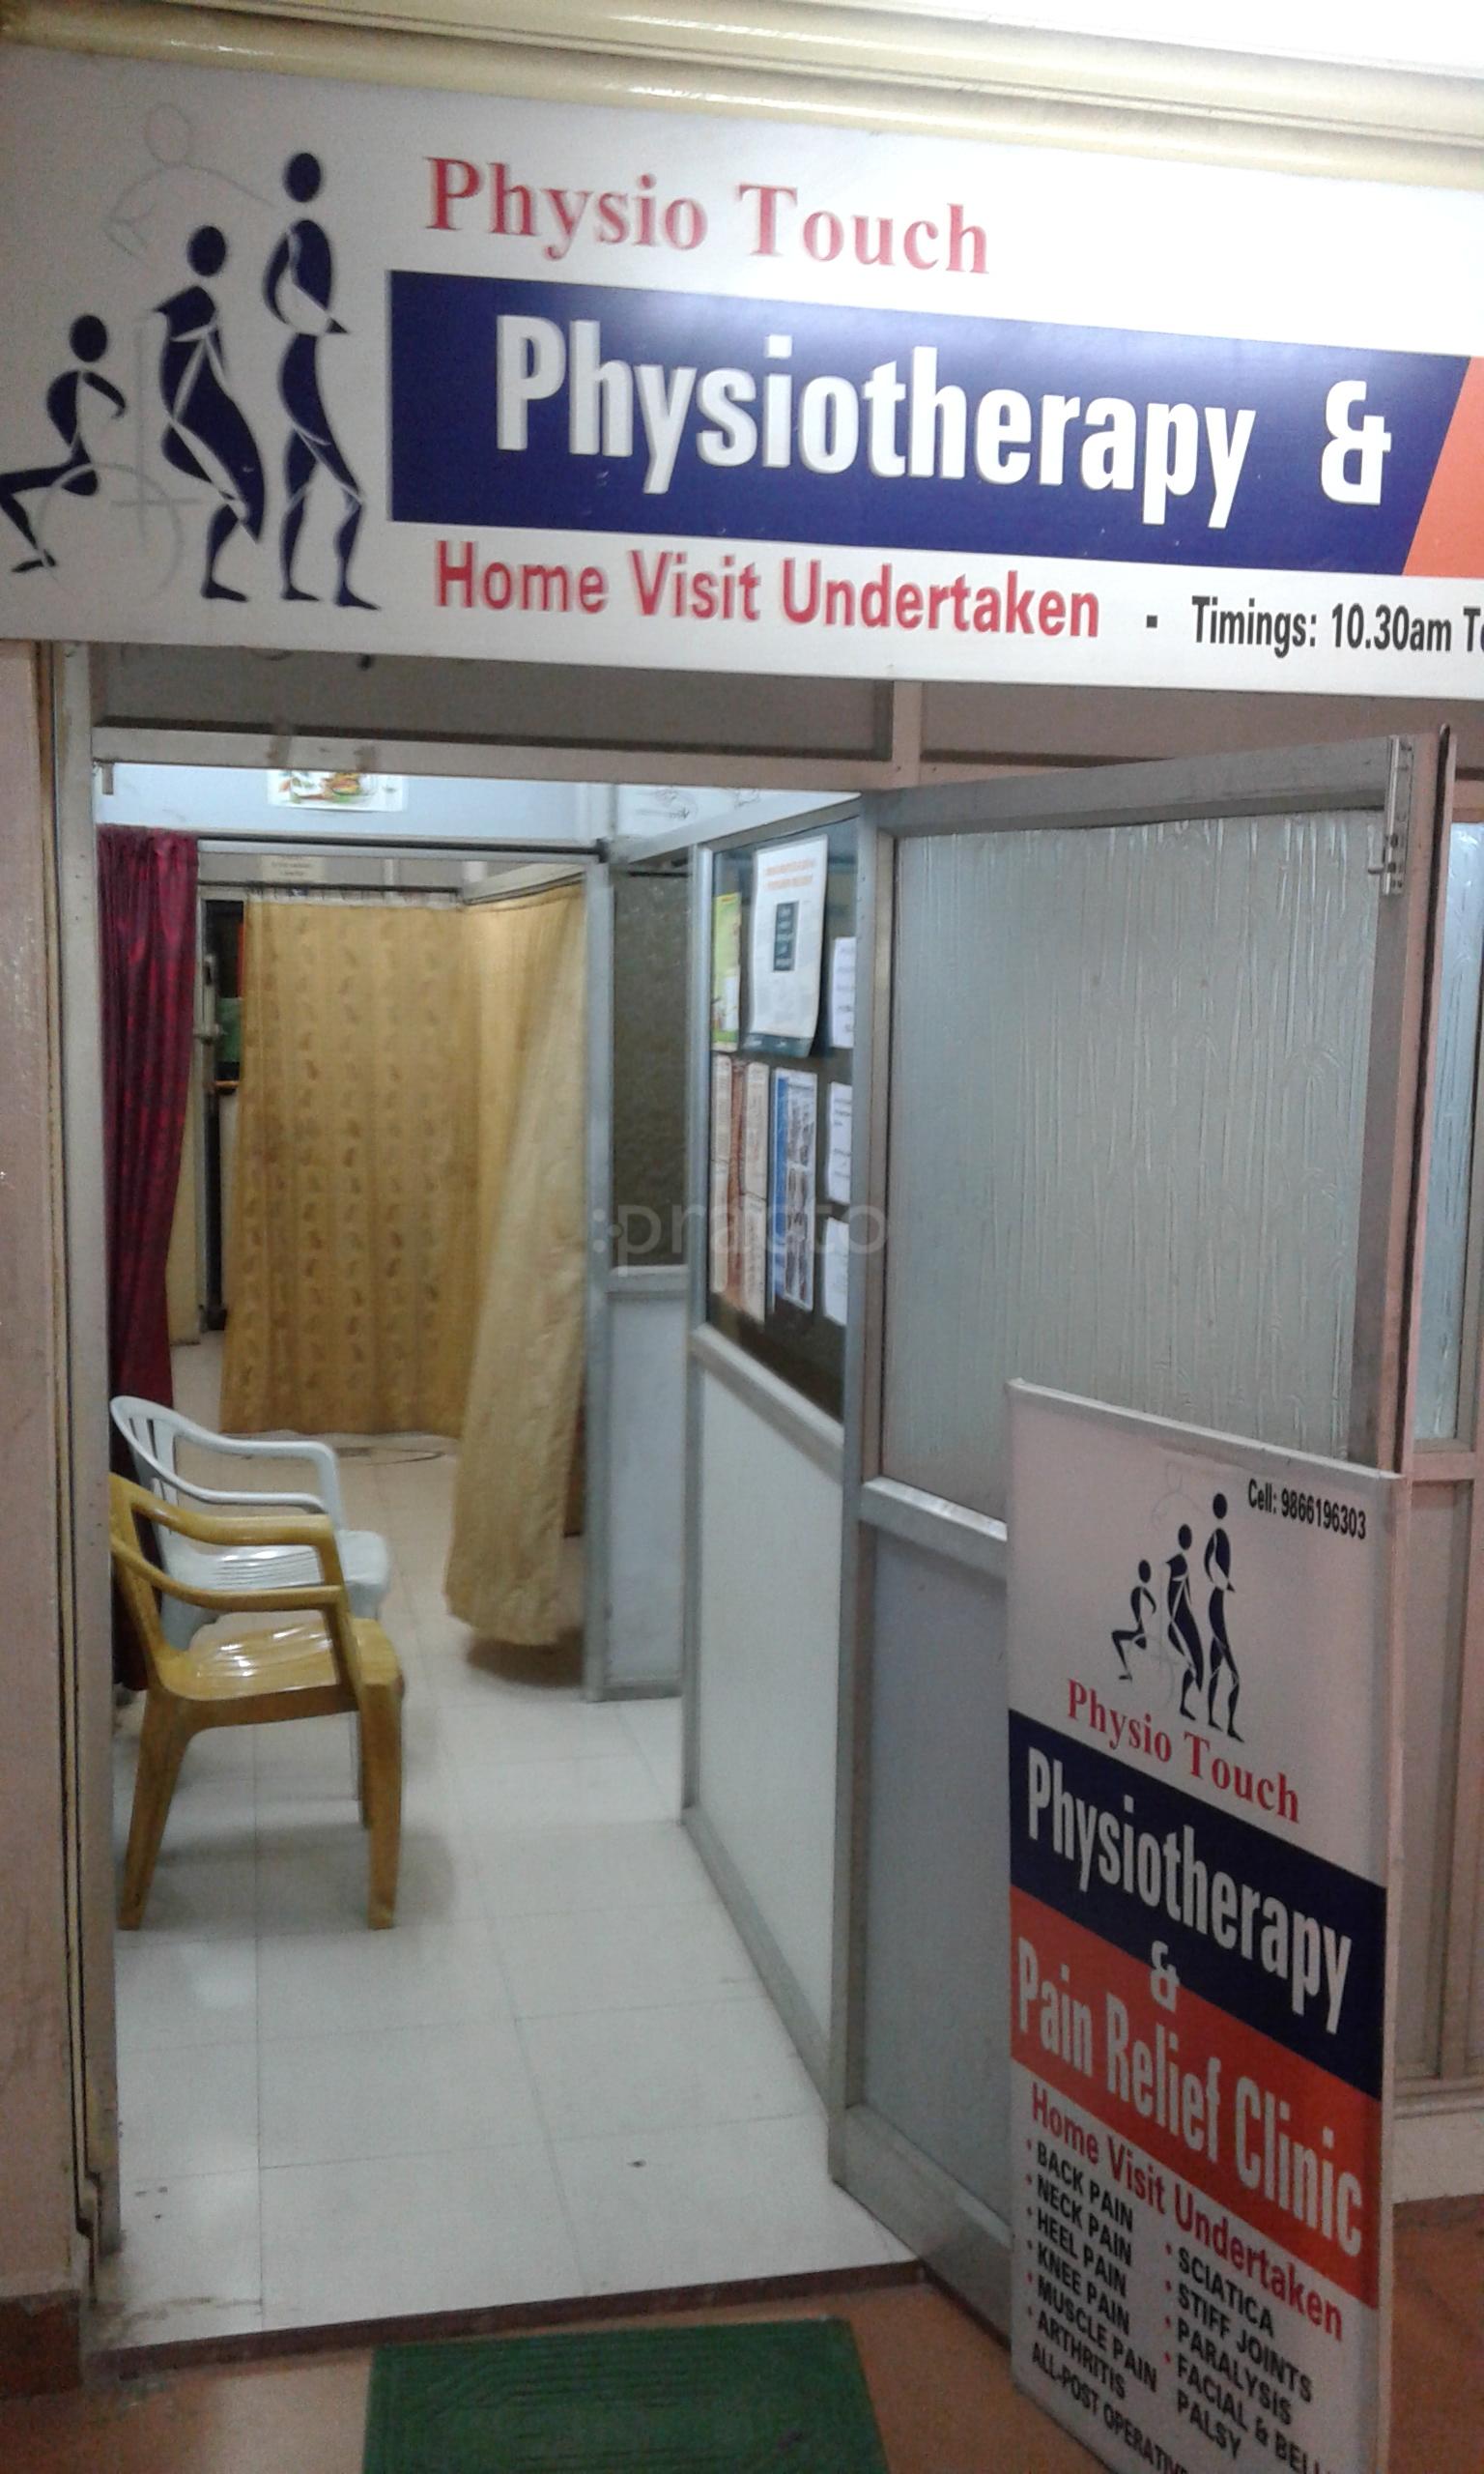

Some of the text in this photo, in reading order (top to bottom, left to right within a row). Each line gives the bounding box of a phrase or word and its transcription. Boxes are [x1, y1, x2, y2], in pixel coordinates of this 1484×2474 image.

[422, 156, 989, 274] Physio Touch
[496, 314, 1392, 530] Physiotherapy &
[435, 539, 1099, 638] Home Visit Undertaken
[1191, 595, 1484, 658] Timings: 10.30am T
[1248, 1478, 1367, 1539] Cell: 9866196303
[1068, 1678, 1300, 1825] Physio Touch
[1028, 1746, 1353, 2036] Physiotherapy
[1150, 1940, 1180, 2014] &
[1017, 1936, 1363, 2258] Pain Relief Clinic
[1031, 2081, 1344, 2343] Home Visit Undertaken
[1037, 2140, 1133, 2233] BACK PAIN
[1037, 2173, 1132, 2267] NECK PAIN
[1037, 2207, 1127, 2298] HEEL PAIN
[1037, 2240, 1130, 2336] KNEE PAIN
[1178, 2246, 1274, 2339] SCIATICA
[1037, 2275, 1157, 2394] MUSCLE PAIN
[1037, 2310, 1126, 2399] ARTHRITIS
[1177, 2284, 1313, 2402] STIFF JOINTS
[1177, 2317, 1293, 2426] PARALYSIS
[1177, 2352, 1248, 2432] FACIAL
[1255, 2415, 1270, 2447] &
[1177, 2388, 1242, 2460] PALSY
